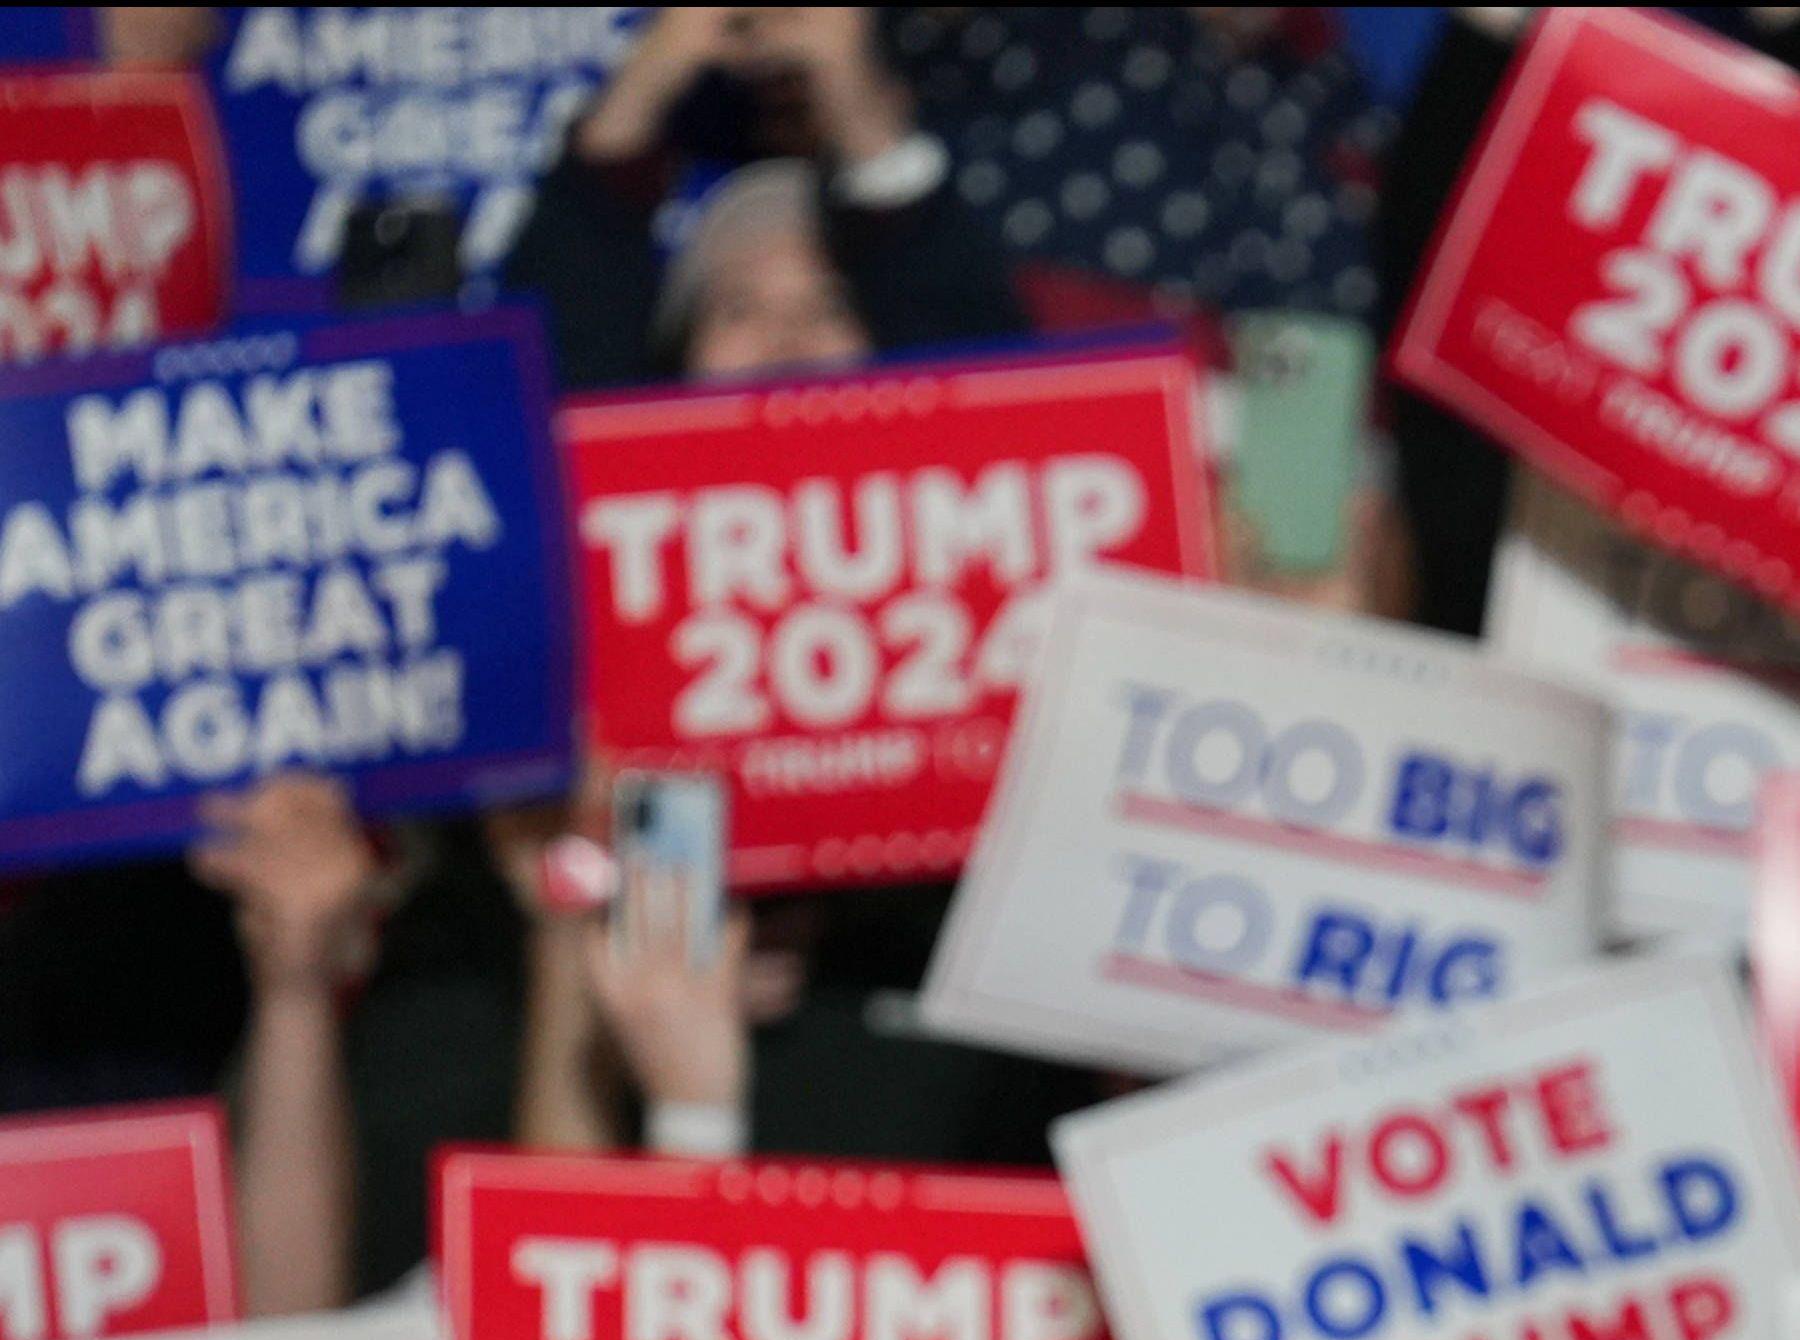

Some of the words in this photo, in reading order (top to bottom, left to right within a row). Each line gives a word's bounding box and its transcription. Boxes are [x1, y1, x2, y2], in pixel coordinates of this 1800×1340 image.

[67, 360, 395, 492] MAKE
[0, 450, 503, 598] AMERICA
[580, 451, 1150, 624] TRUMP
[69, 556, 448, 694] GREAT
[75, 650, 465, 797] AGAIN!
[1115, 682, 1370, 830] TOO
[1383, 748, 1569, 869] BIG
[1108, 852, 1277, 976] TO
[1292, 904, 1507, 1014] RIG
[1259, 1056, 1620, 1228] VOTE
